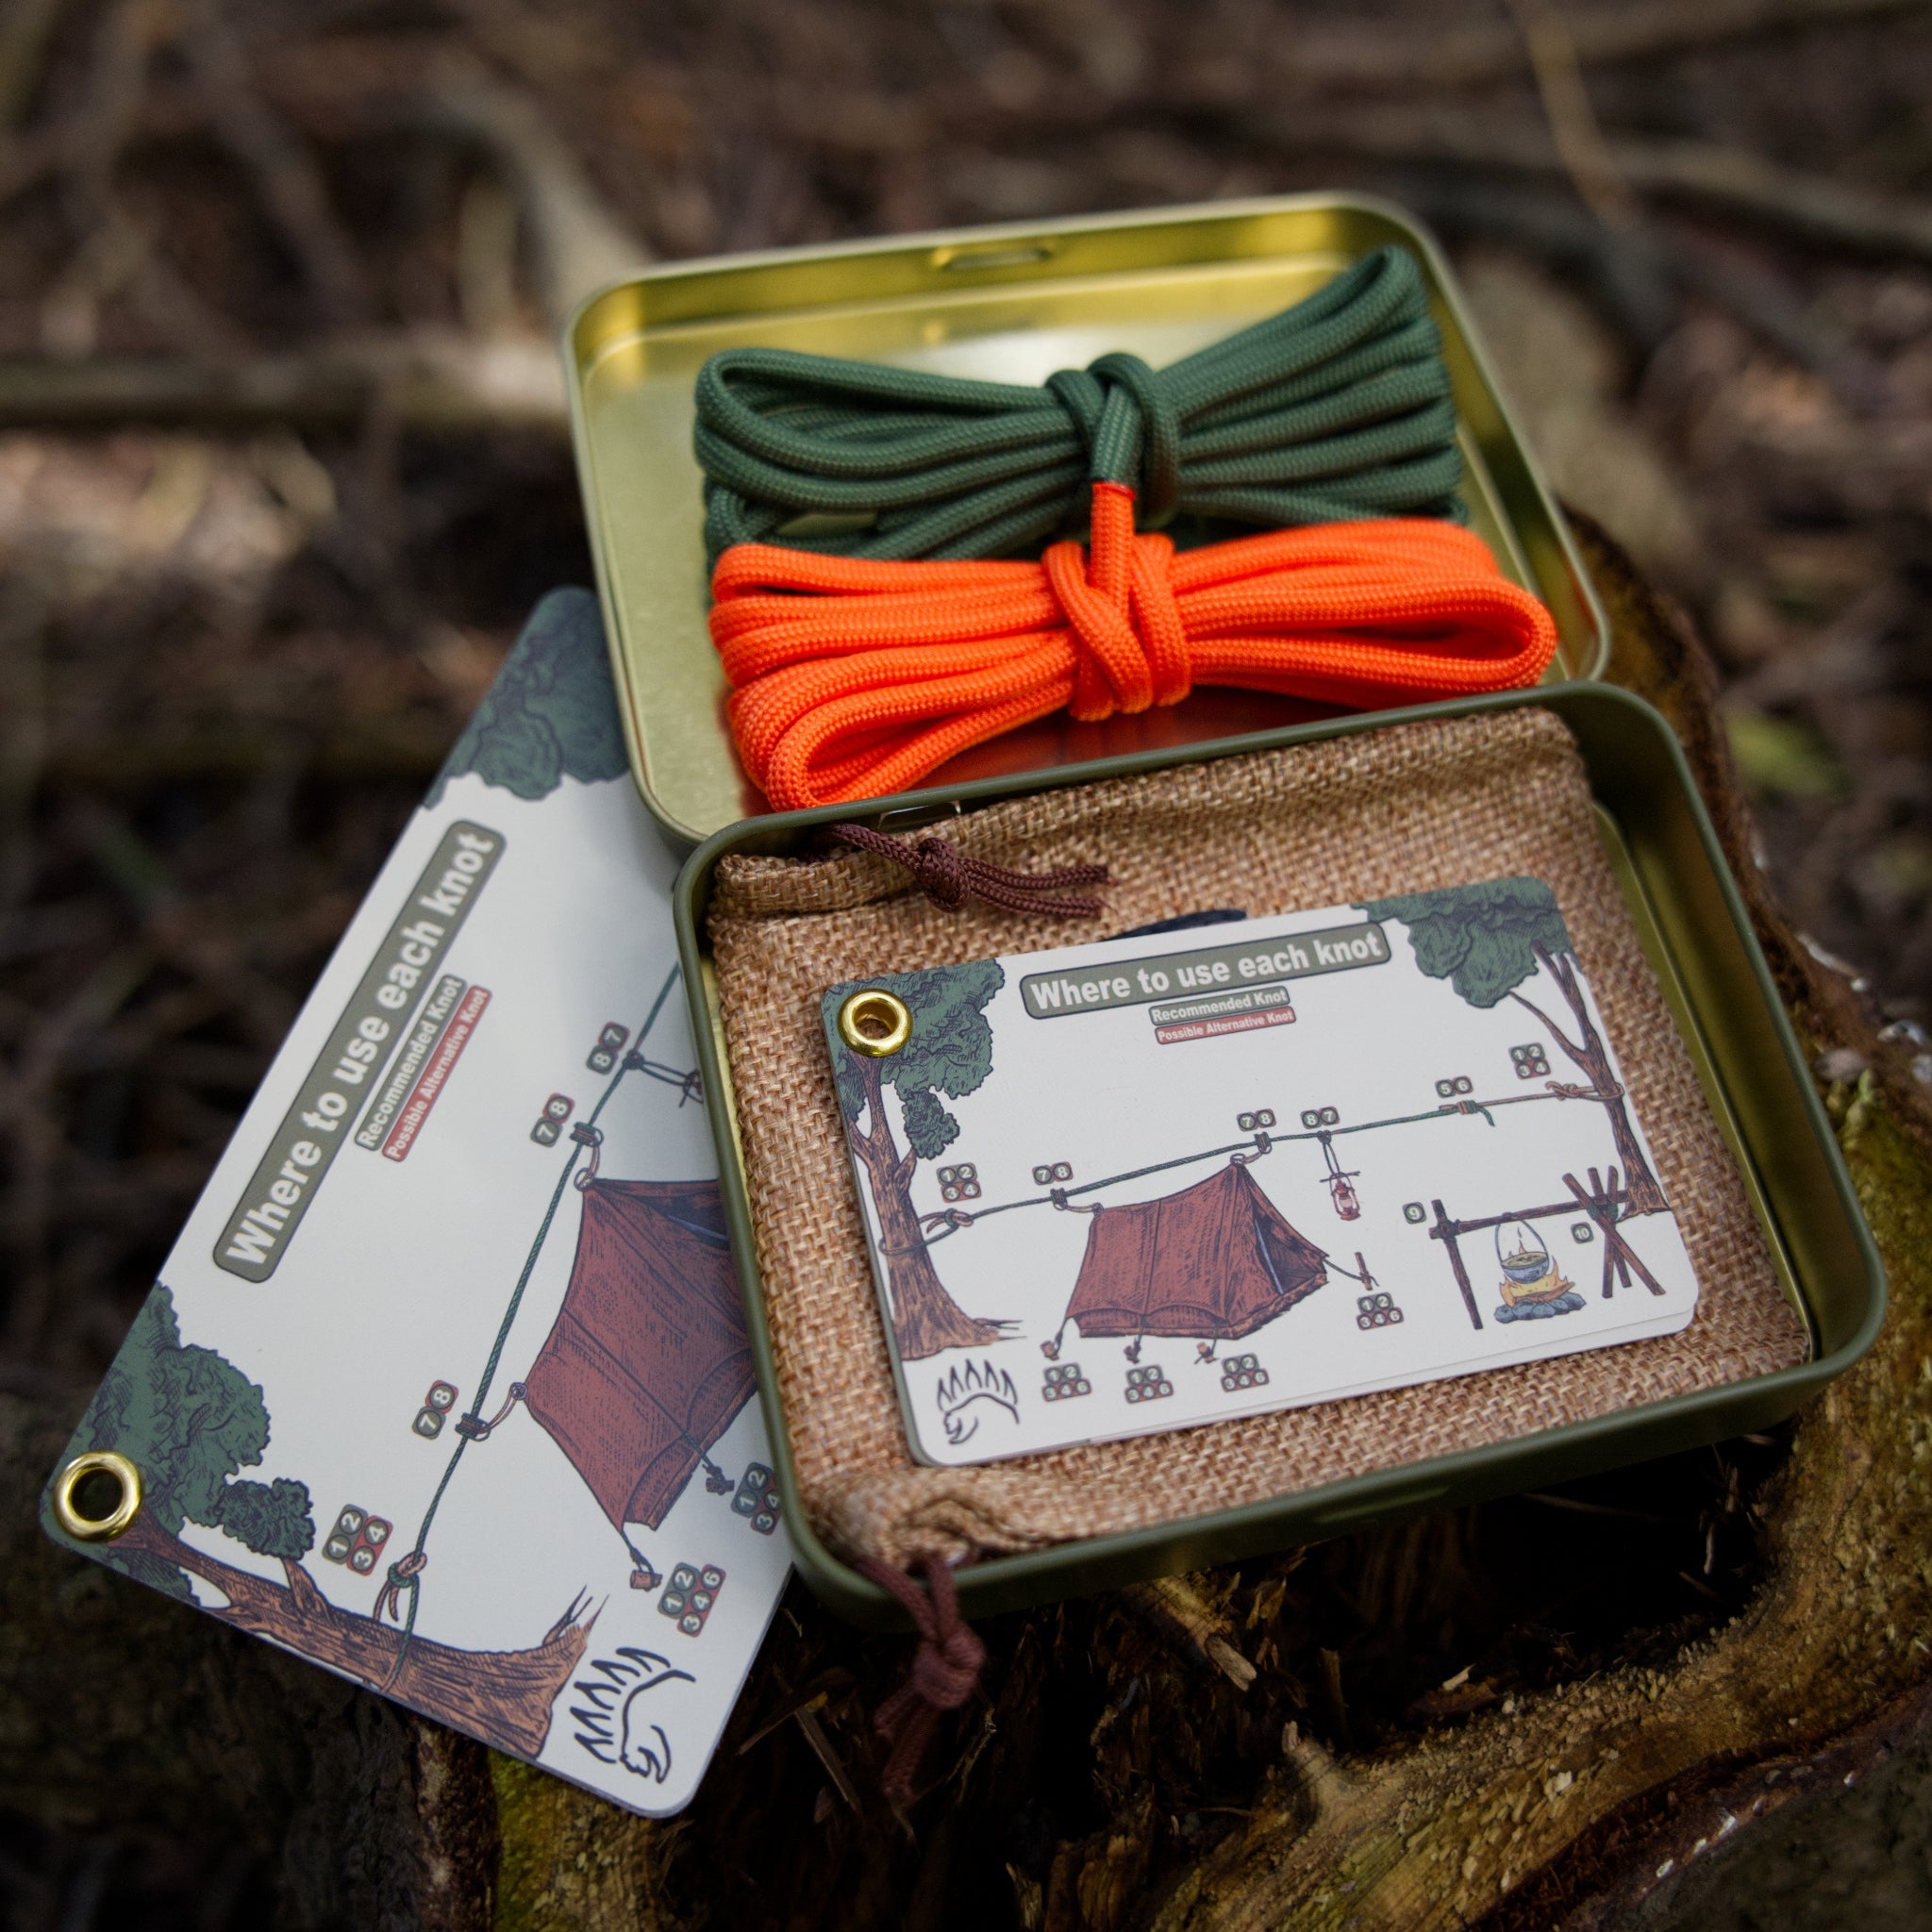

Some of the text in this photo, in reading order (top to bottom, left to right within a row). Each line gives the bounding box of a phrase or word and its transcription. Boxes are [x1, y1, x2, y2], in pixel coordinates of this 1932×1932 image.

[1029, 931, 1382, 1010] Where to use each knot
[1151, 989, 1289, 1024] Recommended Knot
[1158, 1008, 1293, 1042] Possible Alternative Knot
[226, 832, 494, 1265] Where to use each knot
[358, 978, 461, 1147] Recommended Knot
[388, 990, 488, 1158] Possible Alternative Knot
[421, 1390, 450, 1428] 7 8
[748, 1471, 766, 1486] 2
[343, 1514, 360, 1530] 2
[756, 1515, 773, 1529] 3
[354, 1525, 385, 1567] 3 4
[675, 1570, 692, 1587] 2
[683, 1572, 720, 1630] 3 4 6
